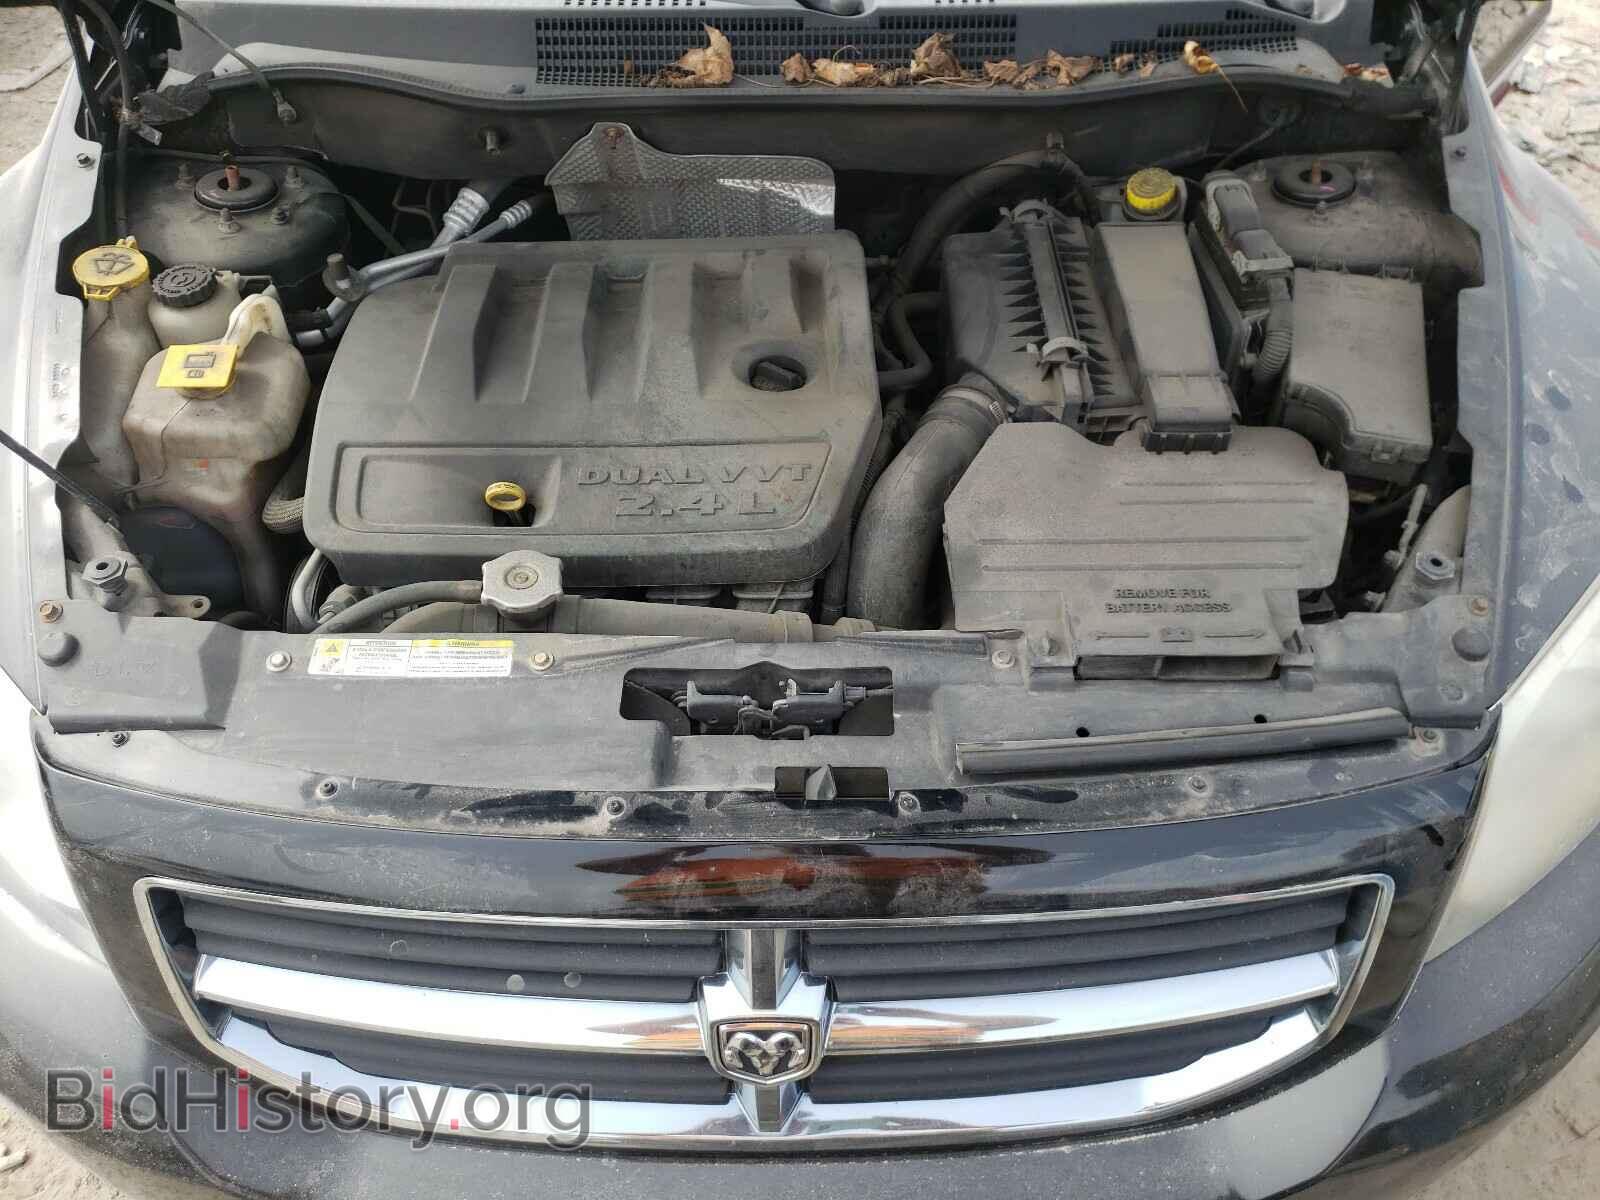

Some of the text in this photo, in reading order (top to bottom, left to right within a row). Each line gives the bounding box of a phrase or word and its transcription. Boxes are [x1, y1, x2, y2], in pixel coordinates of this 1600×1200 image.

[577, 464, 812, 485] DUAL VVT
[1114, 588, 1211, 599] REMOVE FOR
[1105, 603, 1233, 613] BATTERY ACCESS
